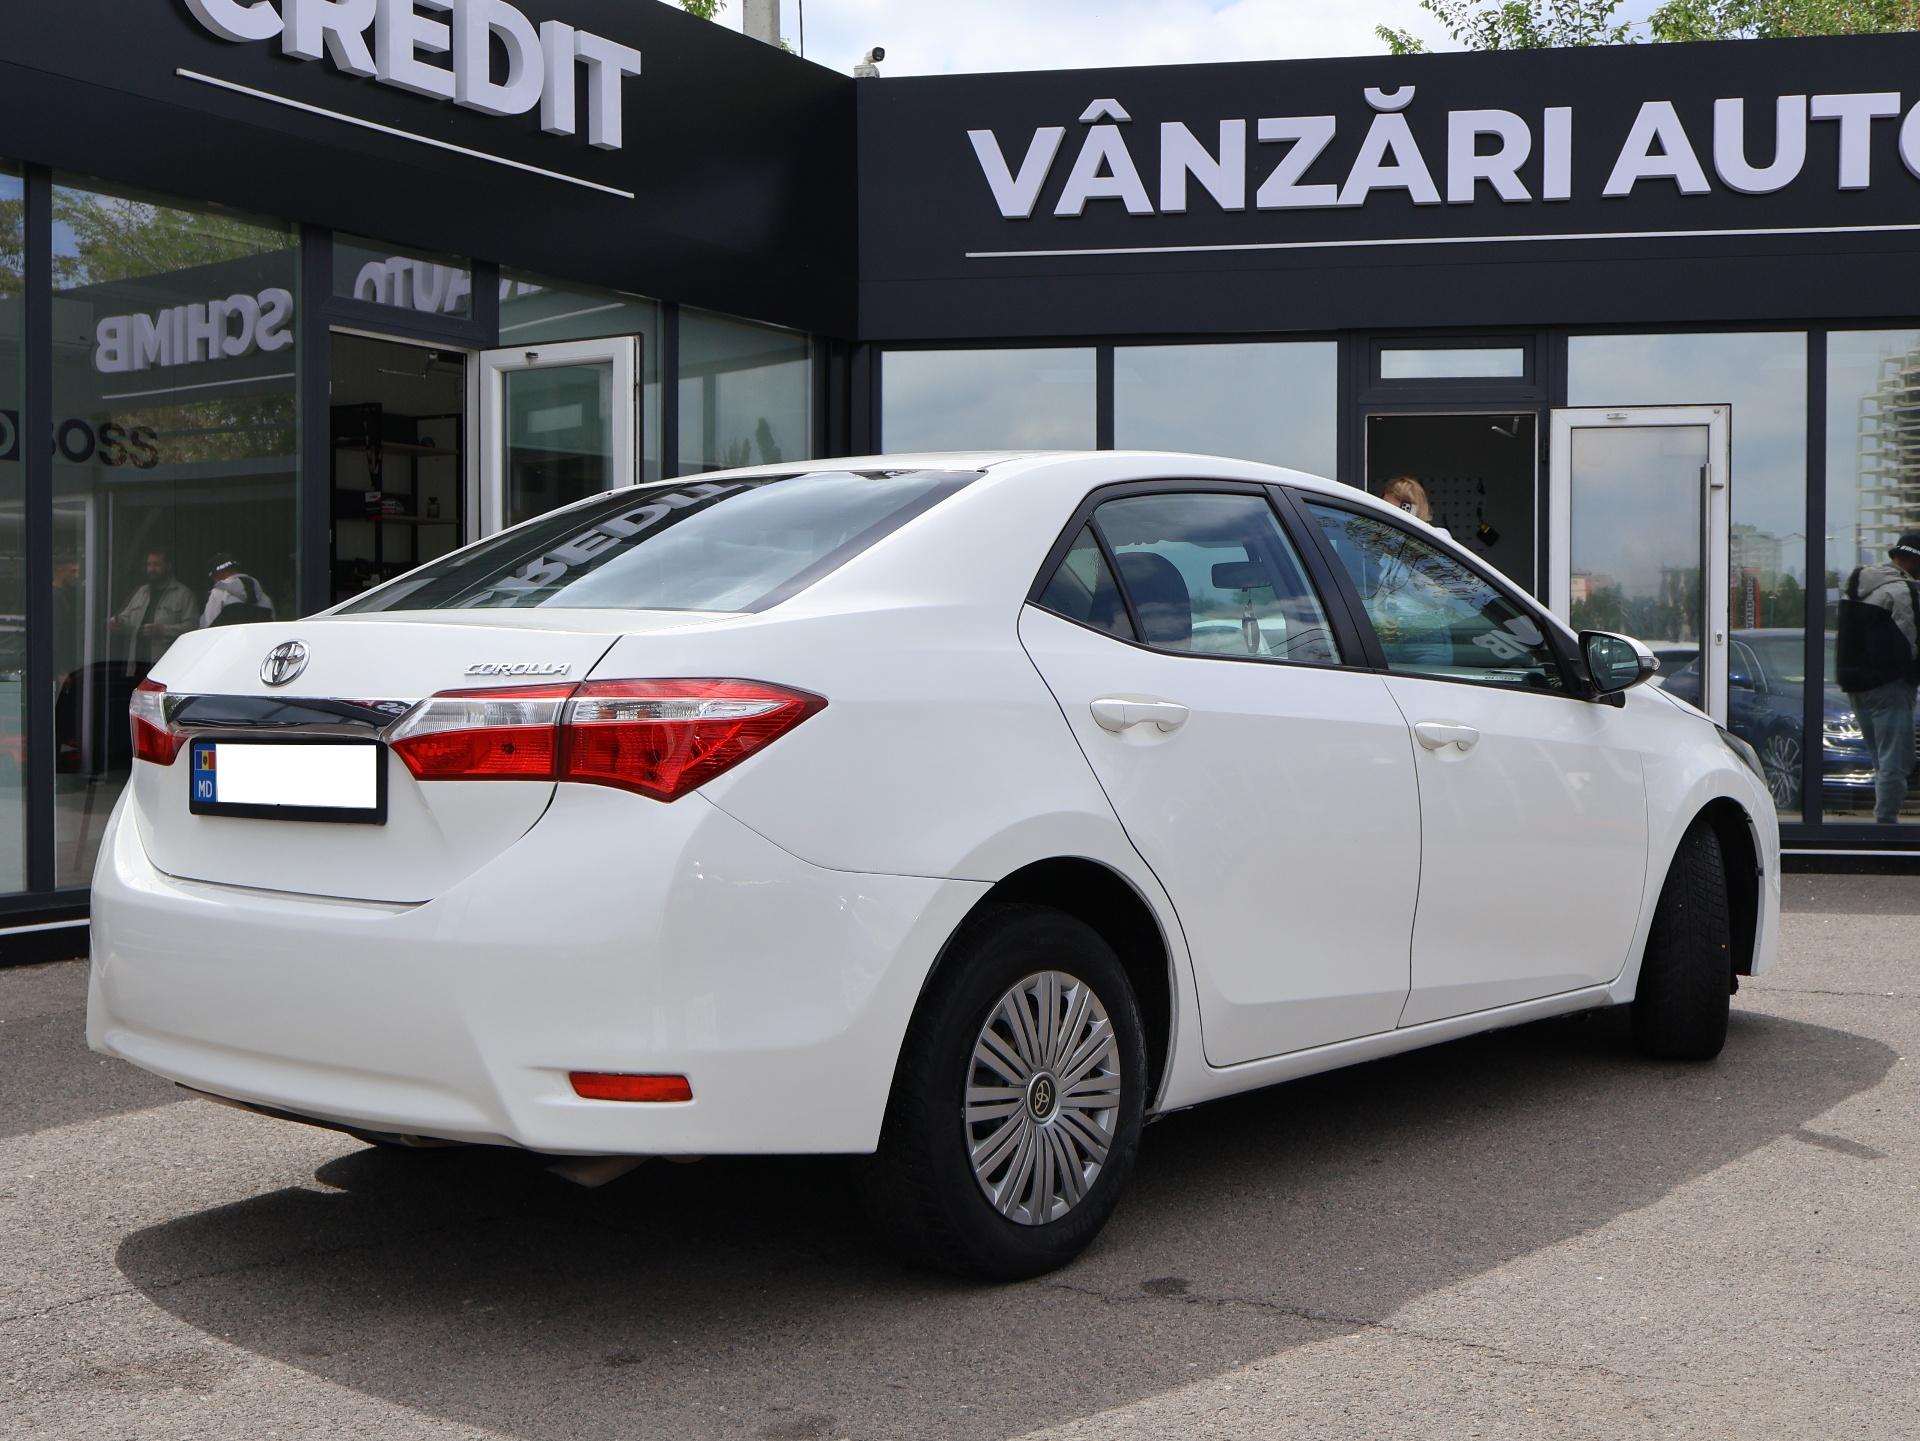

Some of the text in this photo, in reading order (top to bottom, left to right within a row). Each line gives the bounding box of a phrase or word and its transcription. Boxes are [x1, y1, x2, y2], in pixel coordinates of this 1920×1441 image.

[966, 86, 1920, 219] VÂNZĂRI AUT
[51, 418, 159, 470] OSS
[464, 662, 572, 677] COROLLA
[198, 780, 213, 798] MD
